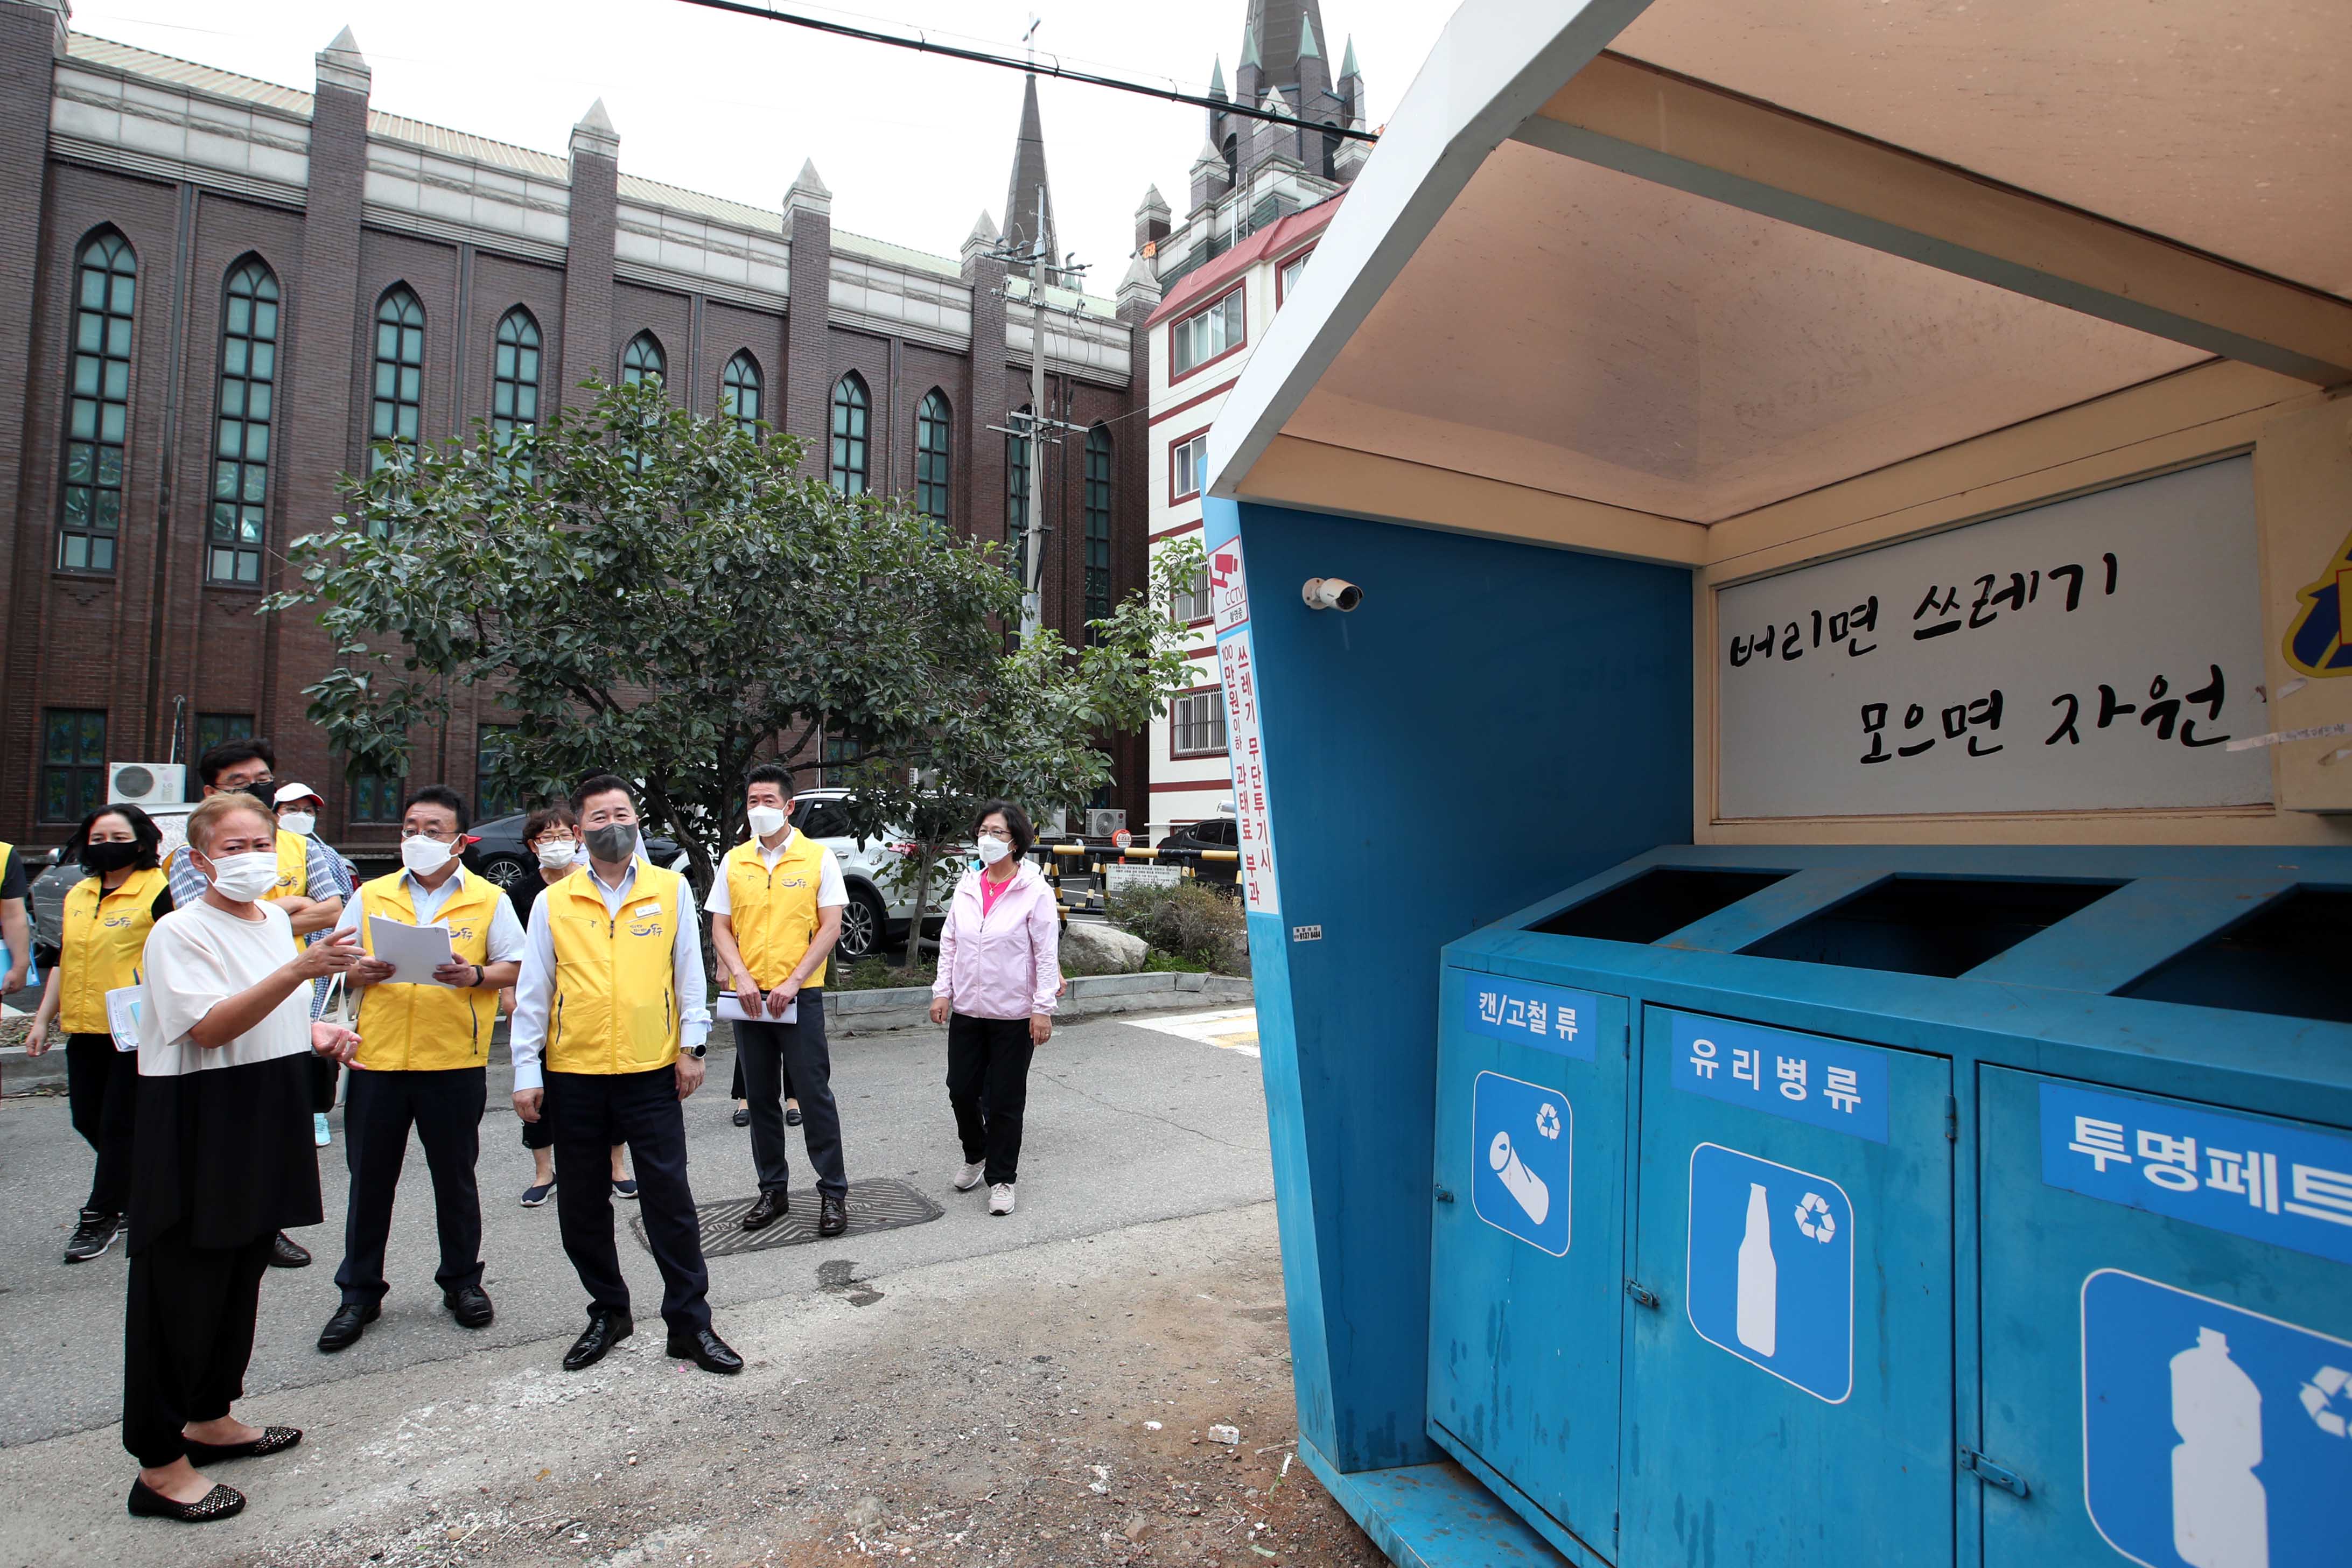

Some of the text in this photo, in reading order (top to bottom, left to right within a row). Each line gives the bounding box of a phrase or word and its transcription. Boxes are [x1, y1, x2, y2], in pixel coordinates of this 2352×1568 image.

[1225, 584, 1243, 606] CCTV
[1730, 552, 2118, 667] 버리면 쓰레기
[1238, 645, 1271, 873] 쓰레기 무단투기시
[1860, 664, 2231, 764] 모으면 자원
[1236, 762, 1253, 840] 과태료
[1245, 853, 1260, 905] 부과
[1479, 991, 1578, 1041] 캔/고철 류
[2068, 1115, 2352, 1227] 투명페트
